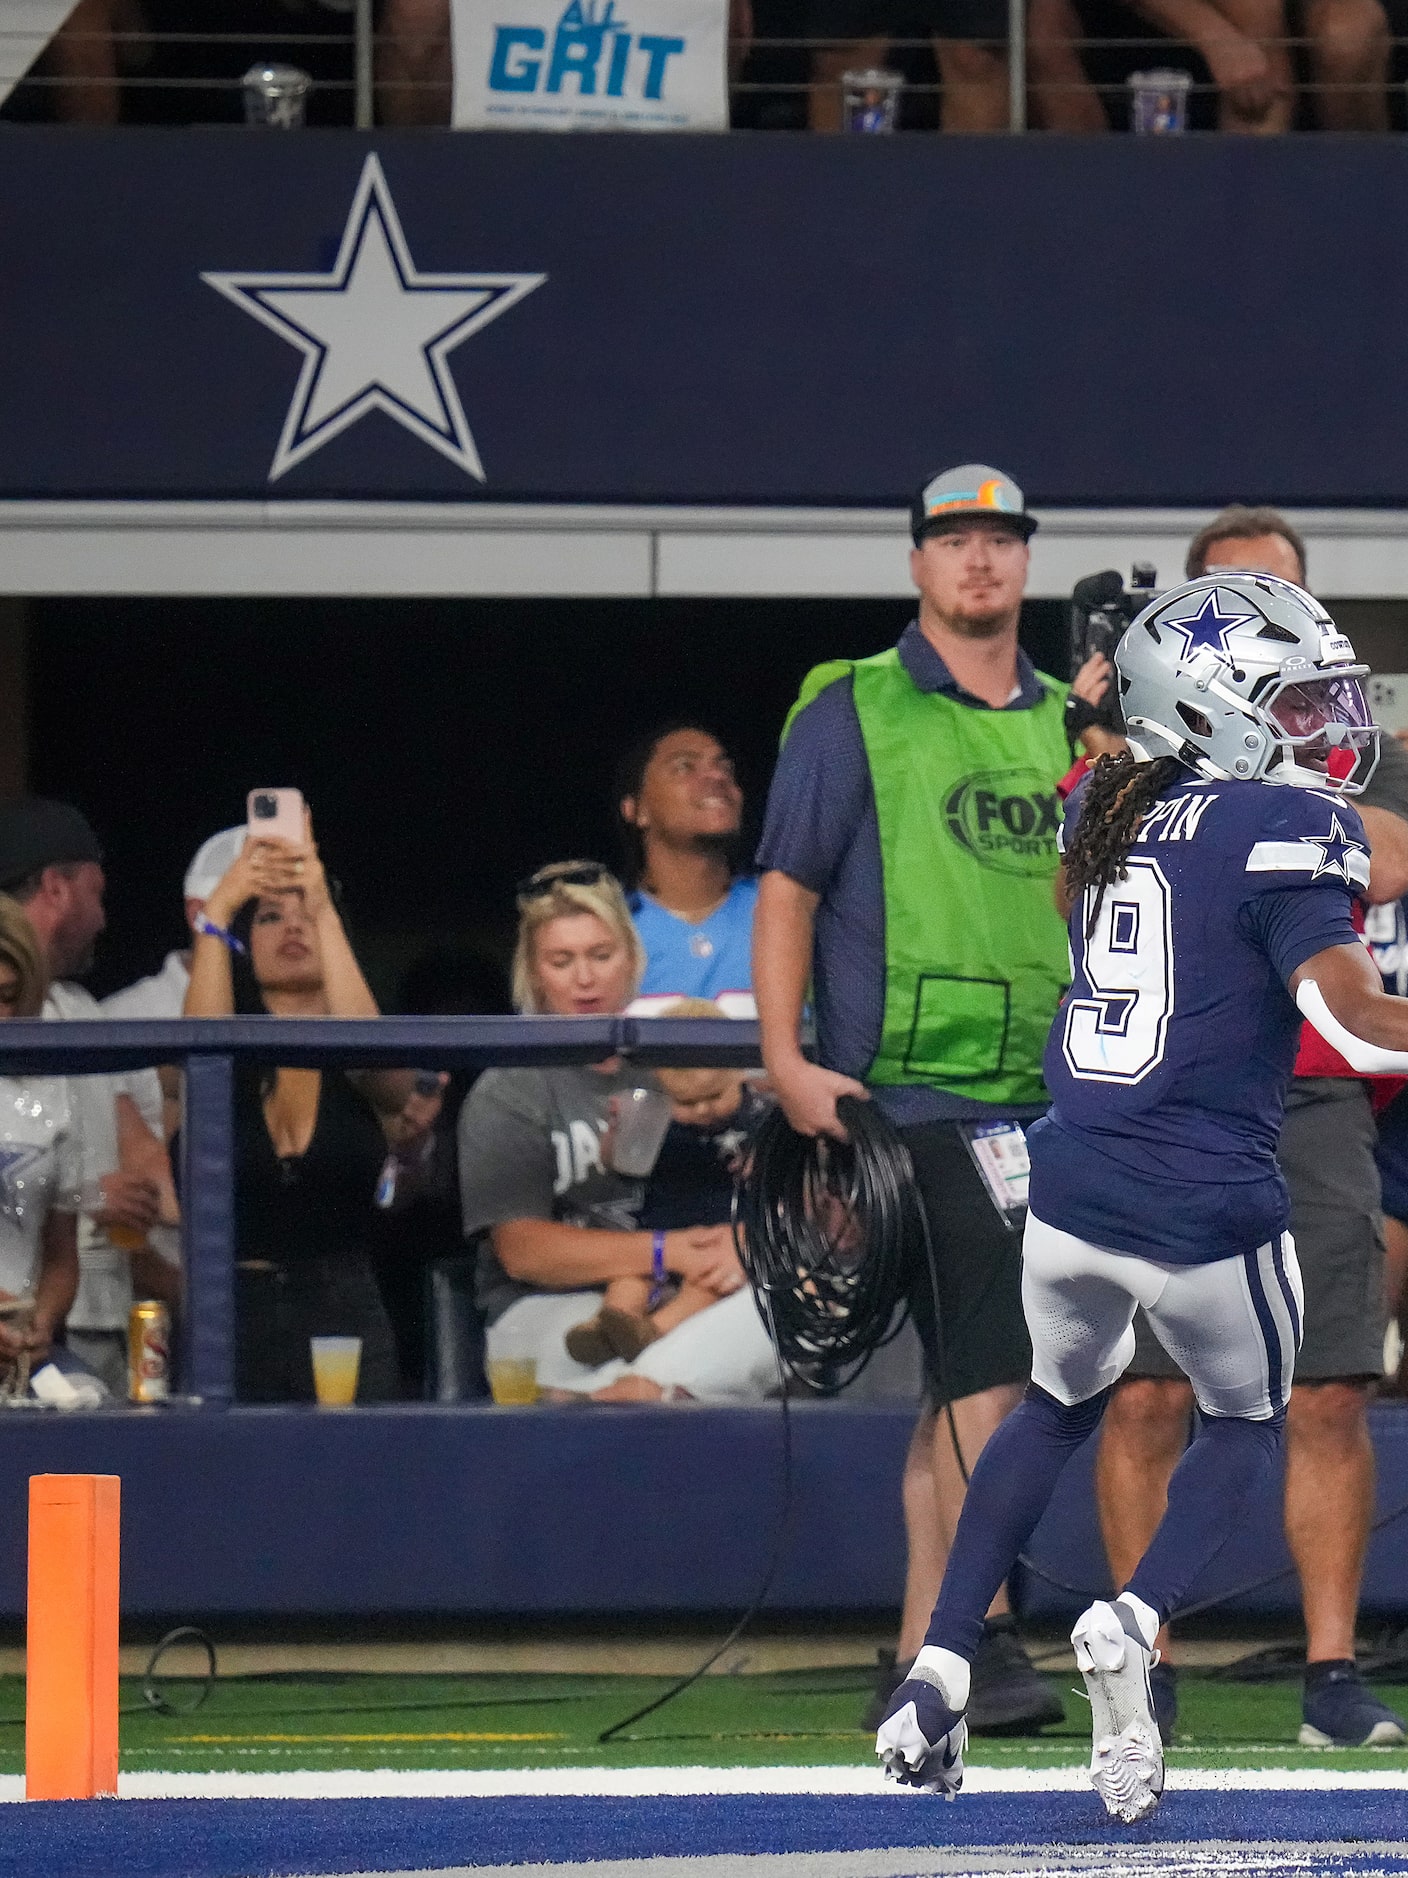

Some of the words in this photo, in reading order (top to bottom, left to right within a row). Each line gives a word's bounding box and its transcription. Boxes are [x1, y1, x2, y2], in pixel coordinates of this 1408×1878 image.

[488, 24, 686, 101] GRIT
[975, 790, 1062, 837] FOX
[979, 833, 1056, 856] SPORT
[1062, 855, 1175, 1086] 9
